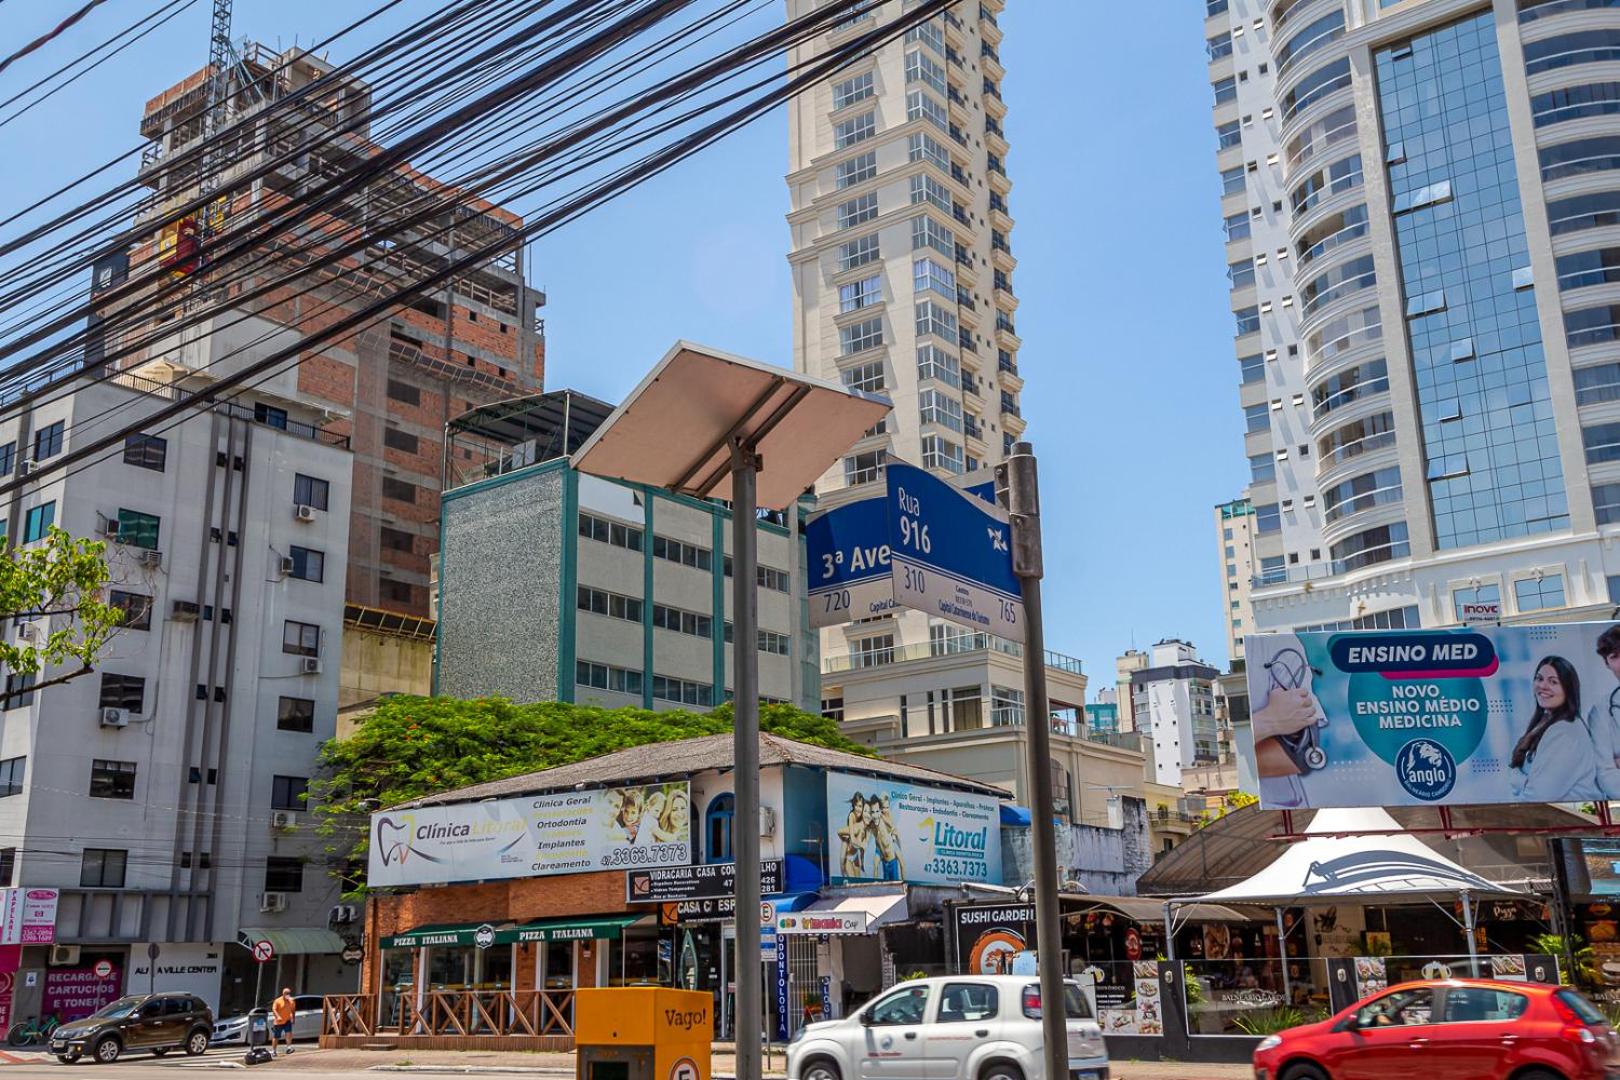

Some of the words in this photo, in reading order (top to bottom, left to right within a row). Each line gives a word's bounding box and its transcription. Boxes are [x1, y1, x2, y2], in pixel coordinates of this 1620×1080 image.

[898, 487, 920, 517] Rua
[900, 516, 931, 554] 916
[822, 550, 843, 579] 3ª
[904, 566, 925, 594] 310
[824, 590, 850, 613] 720
[999, 599, 1016, 624] 765
[1348, 645, 1426, 664] ENSINO
[1432, 643, 1478, 661] MED
[1392, 684, 1440, 700] NOVO
[1356, 699, 1422, 715] ENSINO
[1425, 695, 1480, 713] MÉDIO
[1379, 714, 1462, 730] MEDICINA
[1409, 767, 1446, 786] anglo
[566, 796, 592, 806] Geral
[416, 822, 470, 840] Clínica
[537, 817, 588, 829] Ortodontia
[934, 821, 987, 850] Litoral
[537, 839, 585, 850] Implantes
[531, 859, 591, 871] Clareamento
[696, 867, 716, 877] CASA
[933, 858, 988, 878] 3363.7373
[723, 879, 733, 888] 47
[677, 901, 701, 914] CASA
[762, 906, 769, 918] E
[961, 911, 991, 924] SUSHI
[992, 908, 1034, 922] GARDEN
[394, 936, 416, 946] PIZZA
[422, 933, 458, 945] ITALIANA
[519, 931, 545, 941] PIZZA
[552, 928, 593, 939] ITALIANA
[48, 973, 98, 982] RECARGA
[778, 934, 786, 1032] ODONTOLOGIA
[48, 984, 115, 995] CARTUCHOS
[53, 999, 60, 1008] E
[65, 997, 107, 1008] TONERS
[665, 1008, 706, 1030] Vago!
